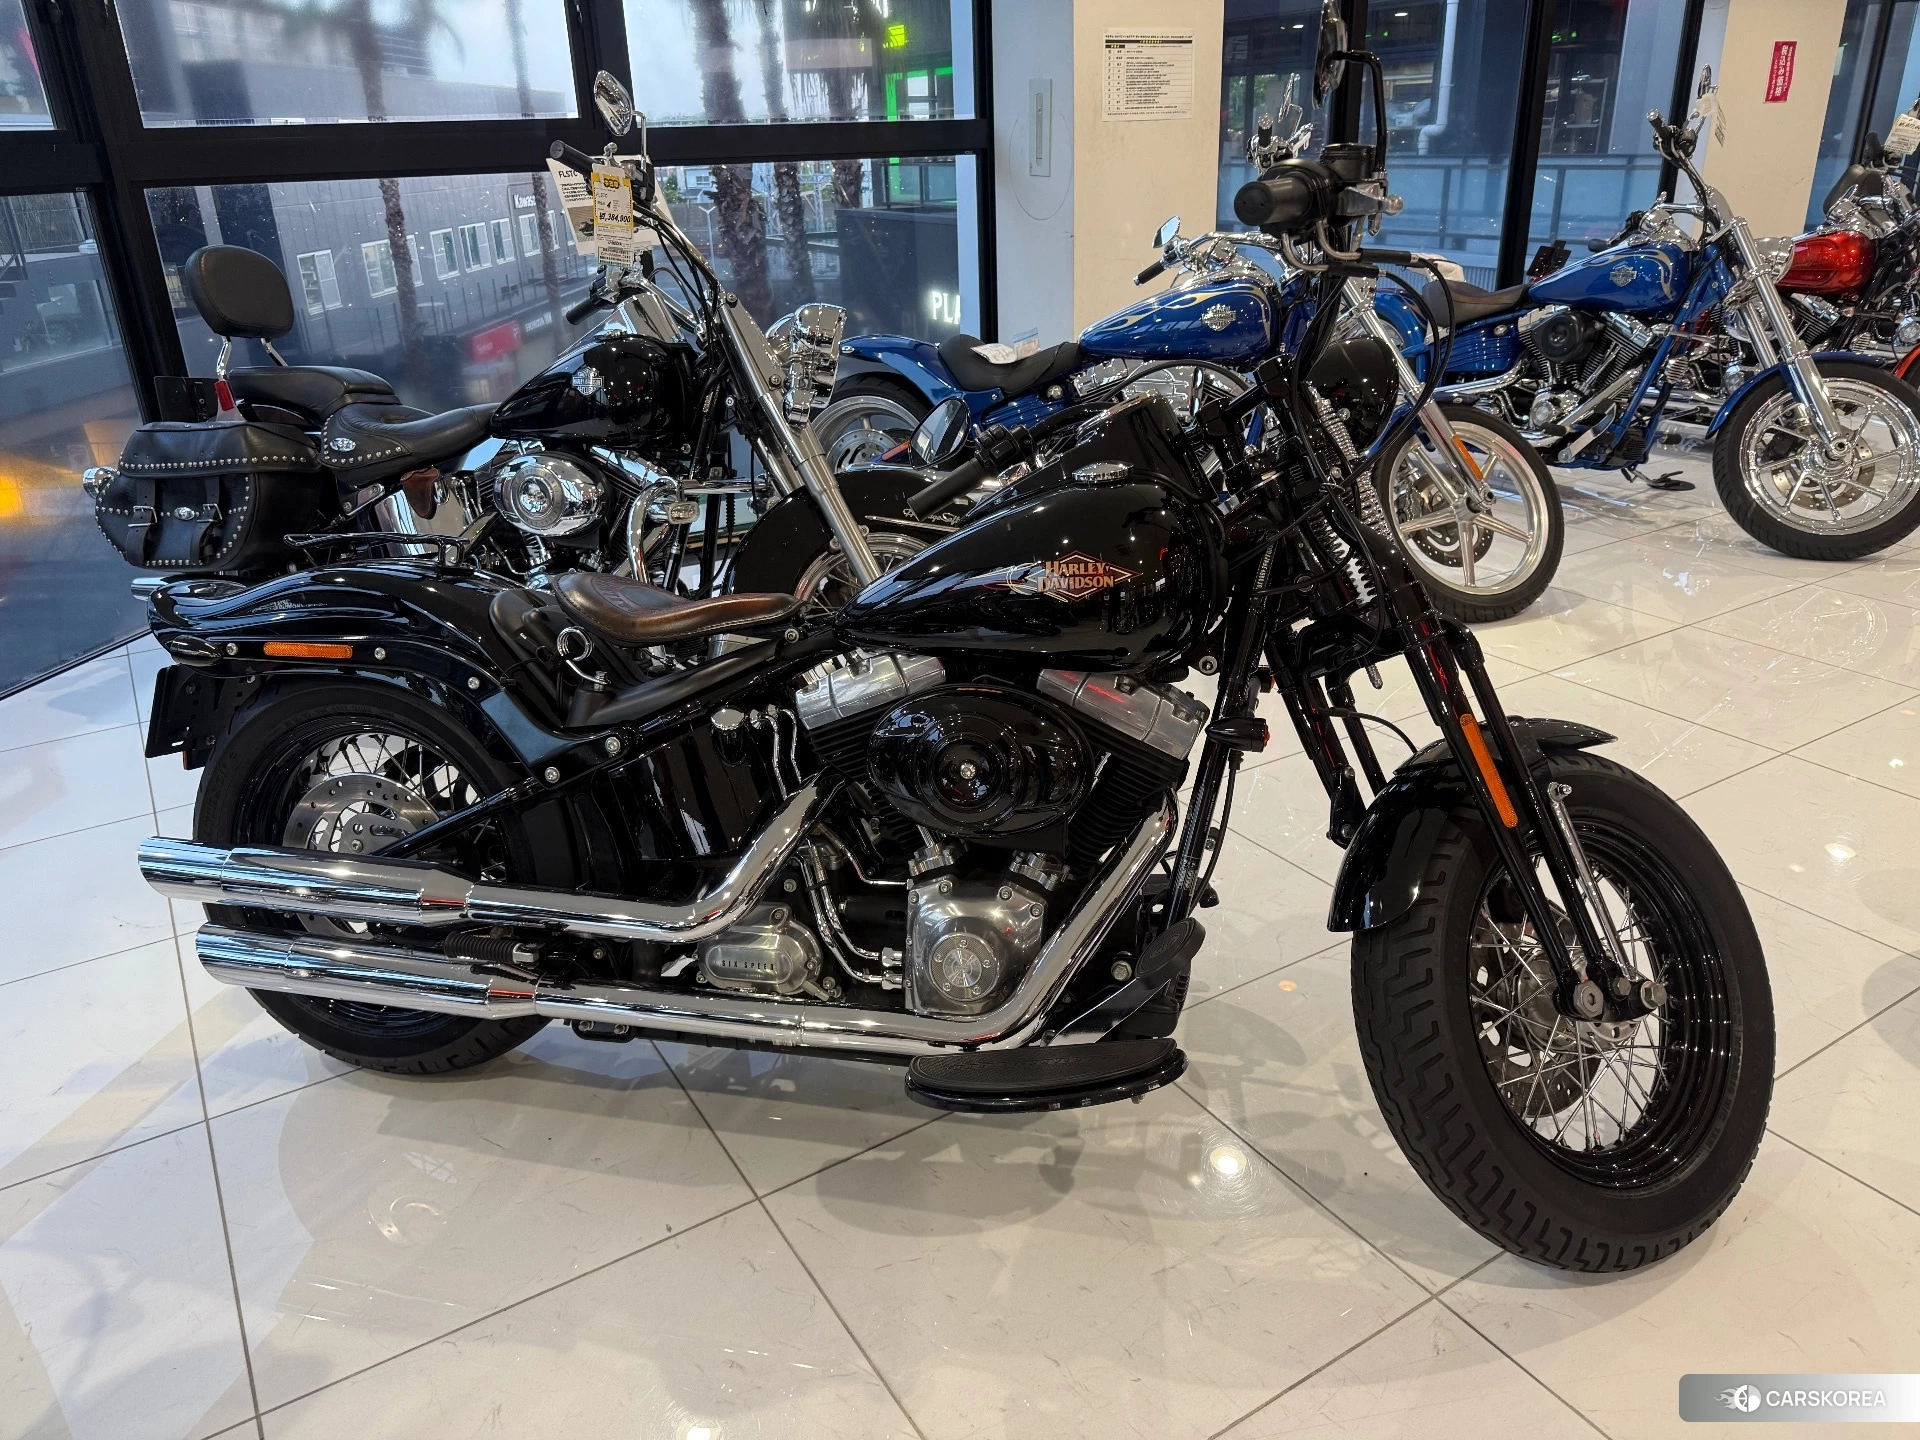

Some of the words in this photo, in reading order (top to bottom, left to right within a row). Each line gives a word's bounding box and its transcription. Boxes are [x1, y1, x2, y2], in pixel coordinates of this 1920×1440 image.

[1775, 44, 1789, 96] 税込み価格
[558, 170, 578, 179] FLSTC
[1045, 561, 1106, 577] HARLEY
[1037, 576, 1115, 593] DAVIDSON
[721, 959, 738, 968] SIX
[744, 961, 774, 970] SPEED
